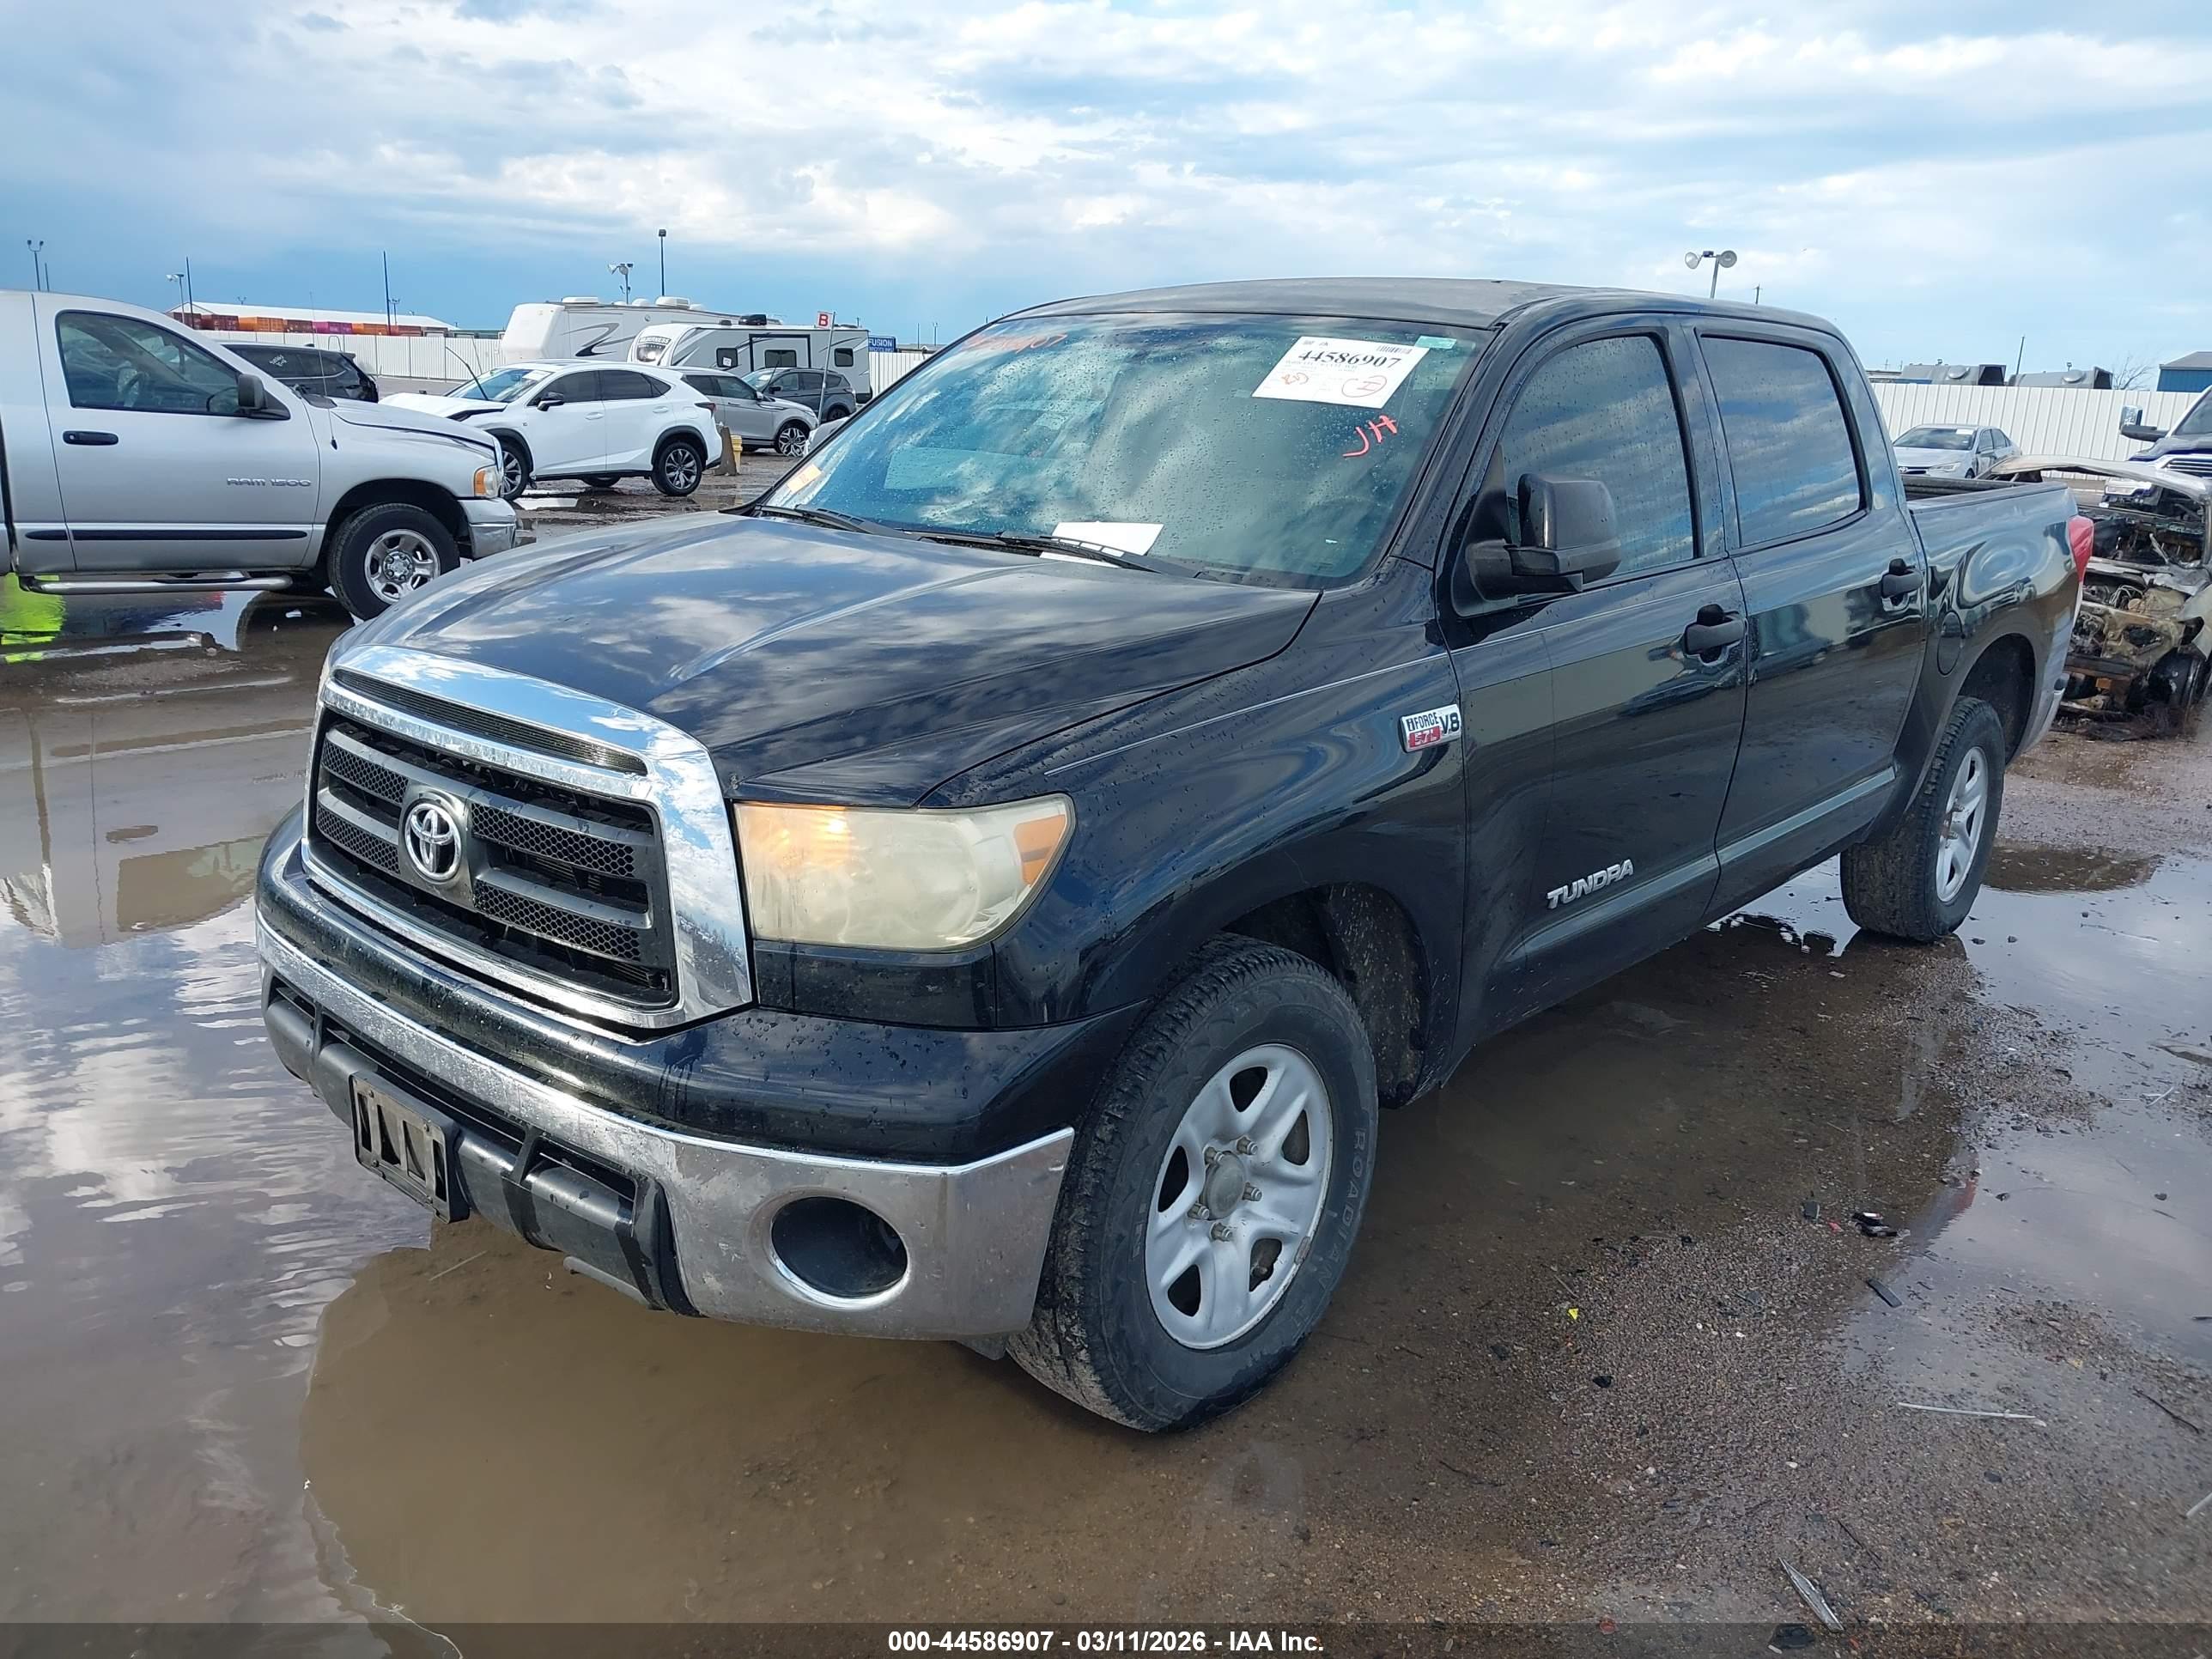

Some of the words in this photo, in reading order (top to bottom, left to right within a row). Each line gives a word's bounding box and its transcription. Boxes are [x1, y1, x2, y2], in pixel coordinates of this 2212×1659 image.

[818, 313, 829, 327] B
[1297, 349, 1402, 369] 44586907
[227, 477, 266, 487] RAM
[270, 477, 312, 488] 1500
[1438, 712, 1460, 734] V8
[1546, 858, 1634, 909] TUNDRA
[1317, 1127, 1367, 1291] ROADIAN
